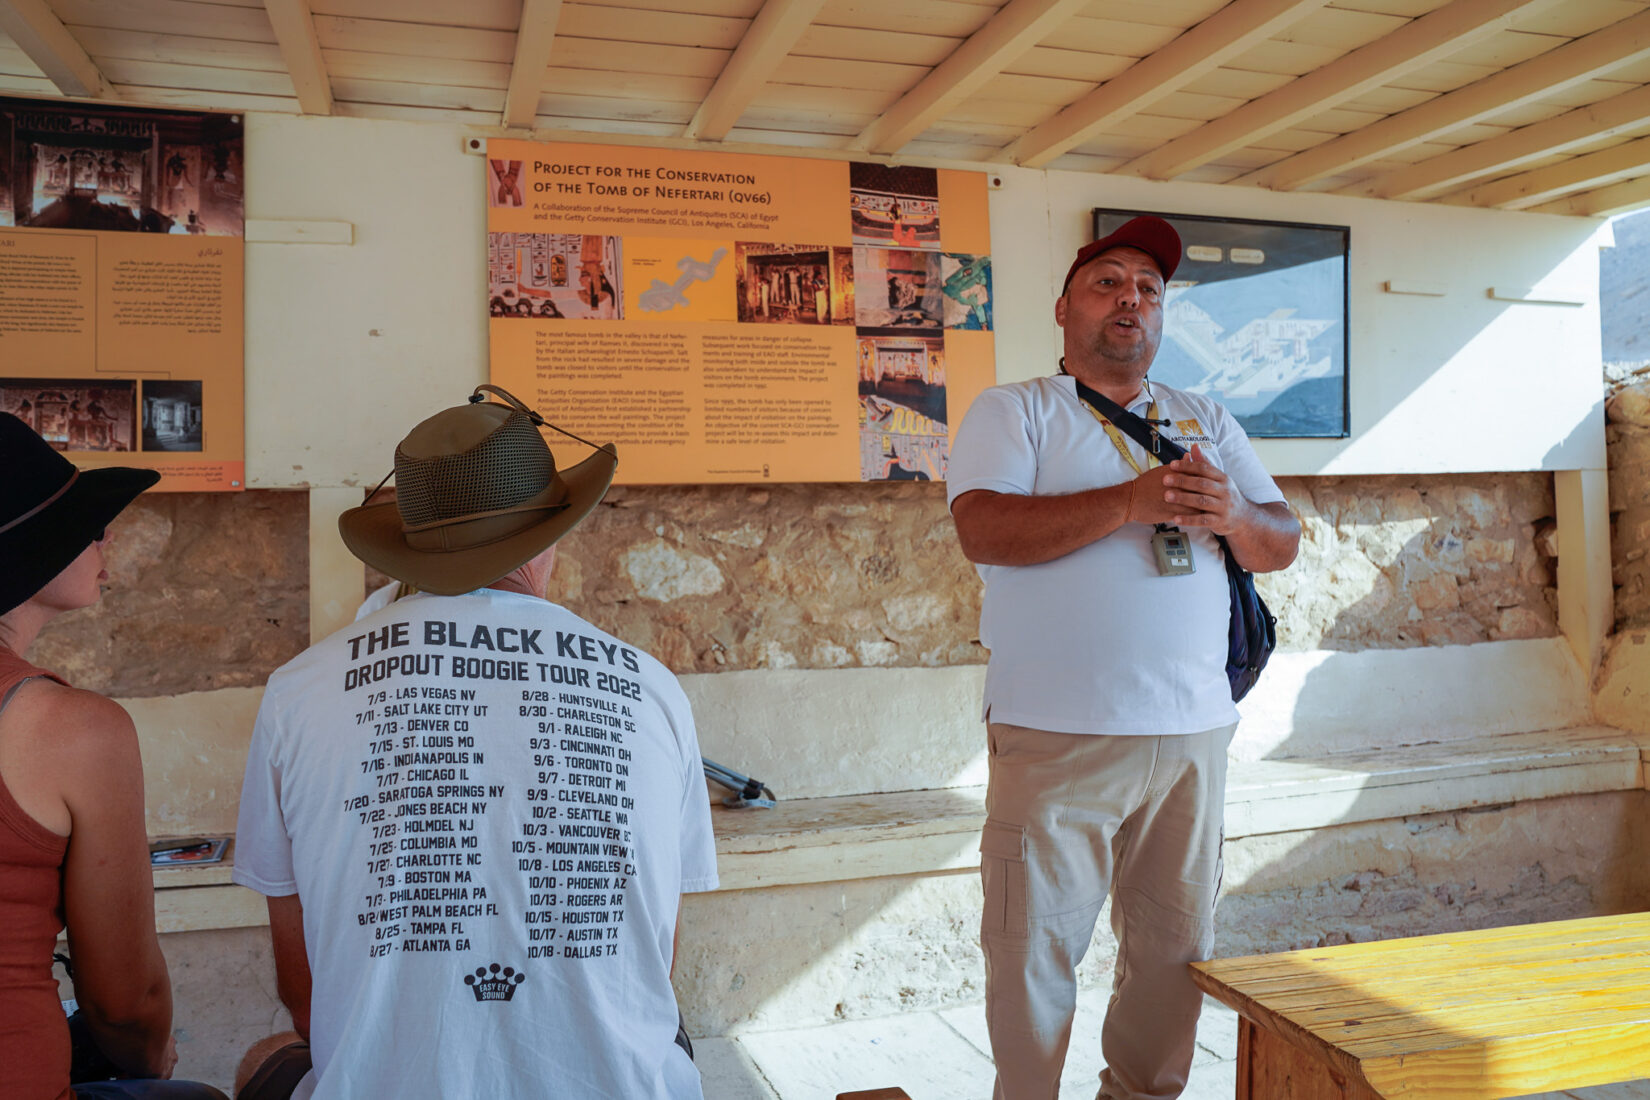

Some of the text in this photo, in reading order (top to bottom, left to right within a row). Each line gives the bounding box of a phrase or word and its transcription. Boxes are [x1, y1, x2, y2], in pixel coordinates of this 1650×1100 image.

[534, 161, 755, 185] PROJECT FOR THE CONSERVATION
[534, 182, 771, 205] OF THE TOMB OF NEFERTARI (QV66)
[542, 204, 591, 212] Collaboration
[618, 206, 649, 214] Supreme
[651, 208, 678, 216] Council
[690, 210, 727, 218] Antiquities
[760, 214, 778, 222] Egypt
[565, 214, 584, 222] Getty
[587, 215, 634, 223] Conservation
[348, 621, 640, 673] THE BLACK KEYS
[344, 655, 642, 701] DROPOUT BOOGIE TOUR 2022
[368, 688, 475, 706] 7/9 LAS VEGAS NV
[522, 691, 632, 718] 8/28 HUNTSVILLE AL
[356, 704, 488, 724] 7/11 SALT LAKE CITY UT
[519, 706, 636, 733] 8/30 CHARLESTON SC
[374, 720, 468, 736] 7/13 DENVER CO
[538, 722, 623, 744] 9/1 RALEIGH NC
[370, 736, 474, 754] 7/15 ST. LOUIS MO
[530, 738, 631, 761] 9/3 CINCINNATI OH
[362, 753, 483, 773] 7/16 INDIANAPOLIS IN
[534, 755, 628, 776] 9/6 TORONTO ON
[377, 769, 469, 787] 7/17 CHICAGO IL
[539, 772, 626, 791] 9/7 DETROIT MI
[344, 786, 504, 811] 7/20 SARATOGA SPRINGS NY
[528, 789, 634, 809] 9/9 CLEVELAND OH
[360, 802, 487, 824] 7/22 JONES BEACH NY
[533, 807, 628, 825] 10/2 SEATTLE WA
[373, 819, 473, 839] 7/23 HOLMDEL NJ
[523, 824, 547, 836] 10/3
[559, 825, 620, 840] VANCOUVER
[370, 837, 477, 856] 7/25 COLUMBIA MD
[512, 841, 535, 853] 10/5
[547, 842, 599, 855] MOUNTAIN
[603, 844, 628, 858] VIEW
[397, 854, 462, 868] CHARLOTTE
[467, 853, 481, 865] NC
[519, 859, 637, 876] 10/8 LOS ANGELES CA
[405, 871, 450, 884] BOSTON
[455, 871, 471, 883] MA
[529, 877, 627, 889] 10/10 PHOENIX AZ
[390, 888, 468, 903] PHILADELPHIA
[473, 887, 487, 899] PA
[530, 894, 623, 906] 10/13 ROGERS AR
[380, 906, 408, 922] WEST
[412, 905, 441, 917] PALM
[446, 905, 482, 917] BEACH
[487, 904, 499, 915] FL
[525, 910, 624, 924] 10/15 HOUSTON TX
[376, 923, 464, 940] 8/25 TAMPA FL
[529, 928, 618, 941] 10/17 AUSTIN TX
[370, 939, 470, 958] 8/27 ATLANTA GA
[527, 944, 617, 959] 10/18 DALLAS TX
[480, 983, 510, 992] EASY EYE
